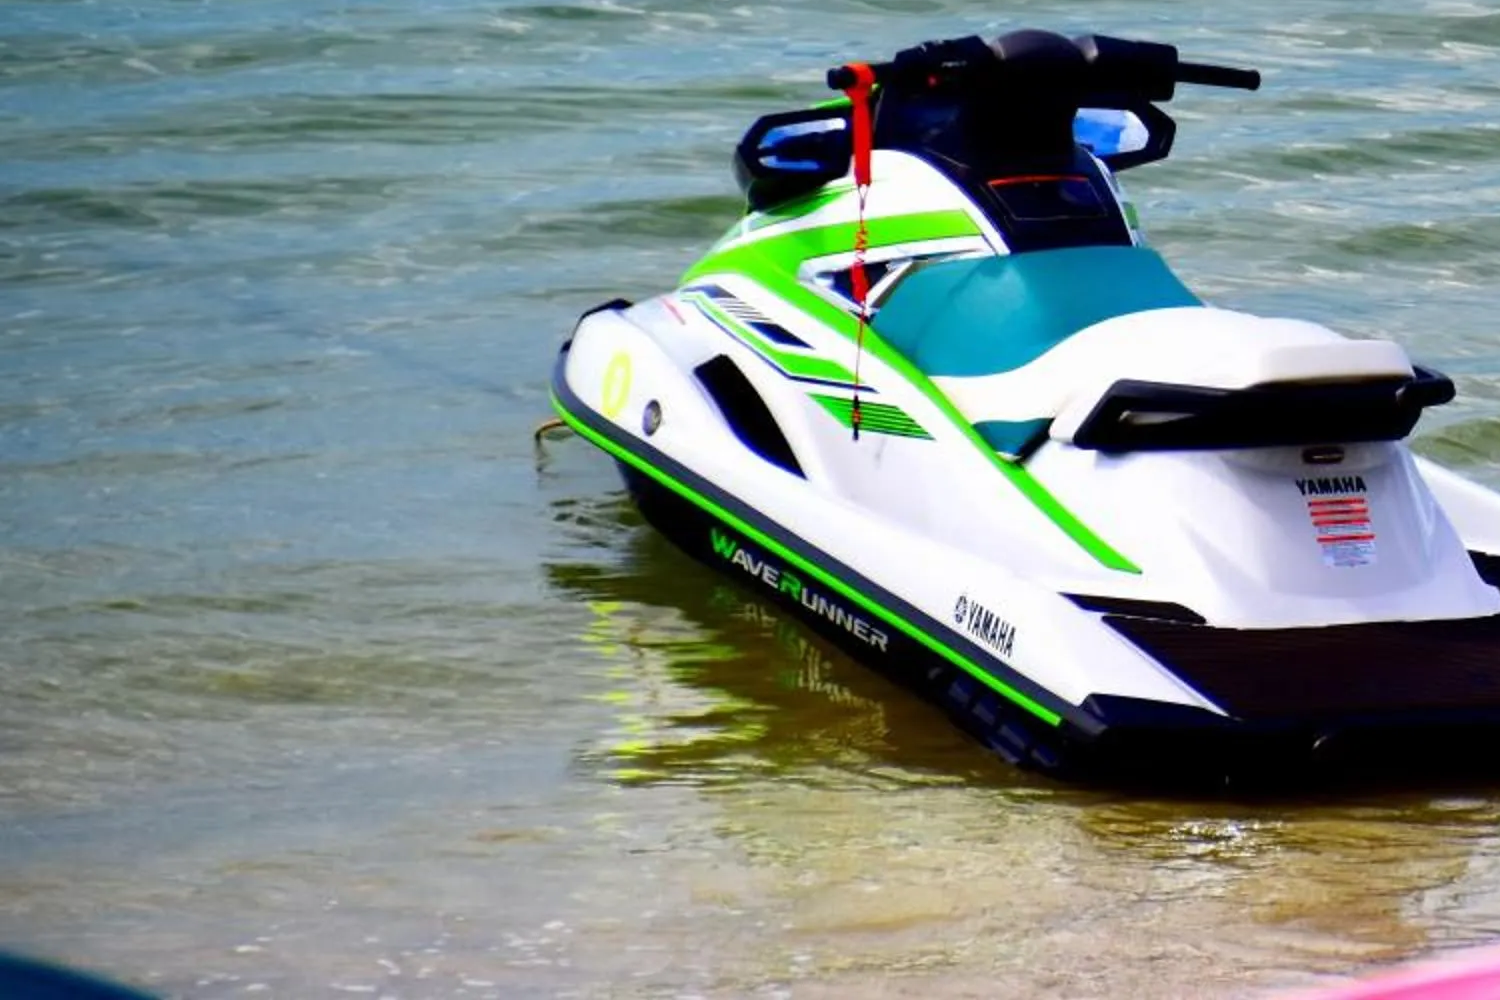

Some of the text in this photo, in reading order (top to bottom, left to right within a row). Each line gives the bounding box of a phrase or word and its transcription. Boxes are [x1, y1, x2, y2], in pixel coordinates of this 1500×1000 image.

[1295, 476, 1367, 496] YAMAHA
[709, 527, 889, 653] WAVERUNNER
[967, 600, 1016, 658] YAMAHA
